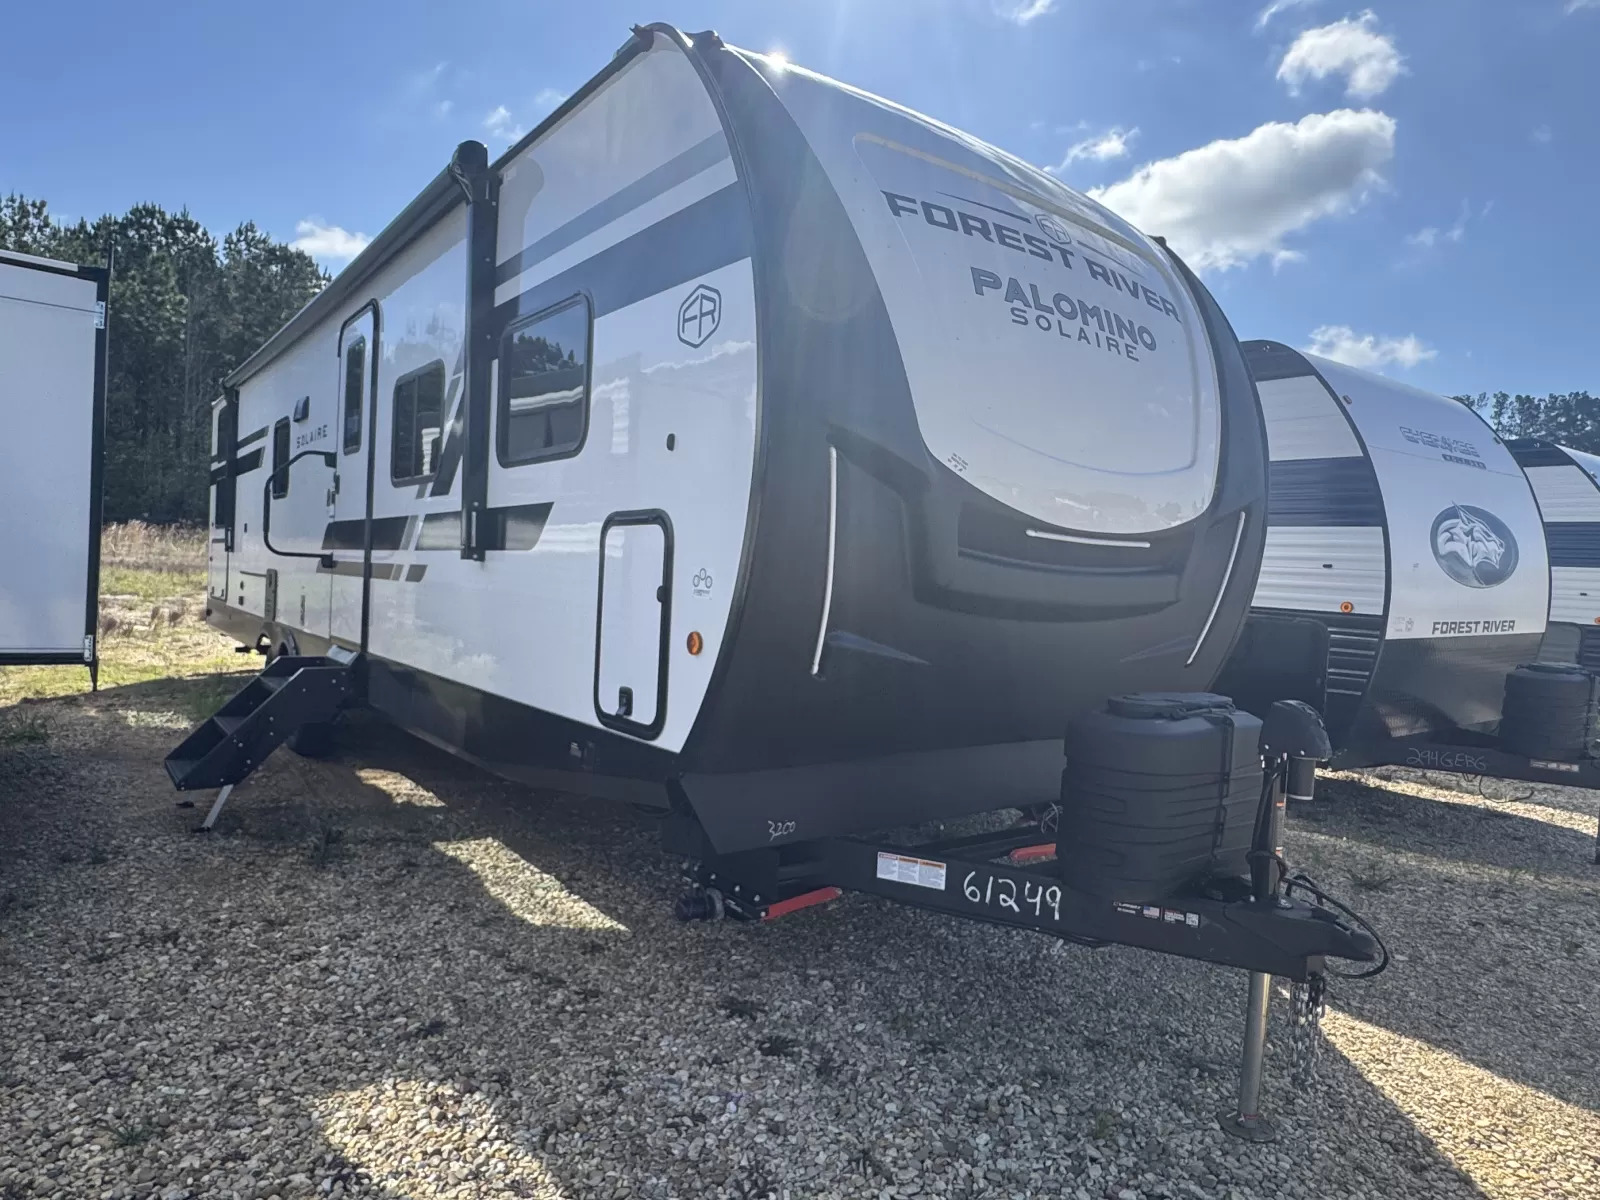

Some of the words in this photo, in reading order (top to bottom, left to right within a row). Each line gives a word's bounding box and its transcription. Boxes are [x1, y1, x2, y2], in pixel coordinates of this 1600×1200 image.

[880, 189, 1075, 270] FOREST
[1082, 255, 1183, 323] RIVER
[970, 266, 1157, 351] PALOMINO
[1010, 306, 1140, 362] SOLAIRE
[296, 424, 329, 449] SOLAIRE
[1432, 620, 1481, 635] FOREST
[1482, 619, 1516, 633] RIVER
[767, 820, 796, 842] 3200
[963, 871, 1062, 920] 61249
